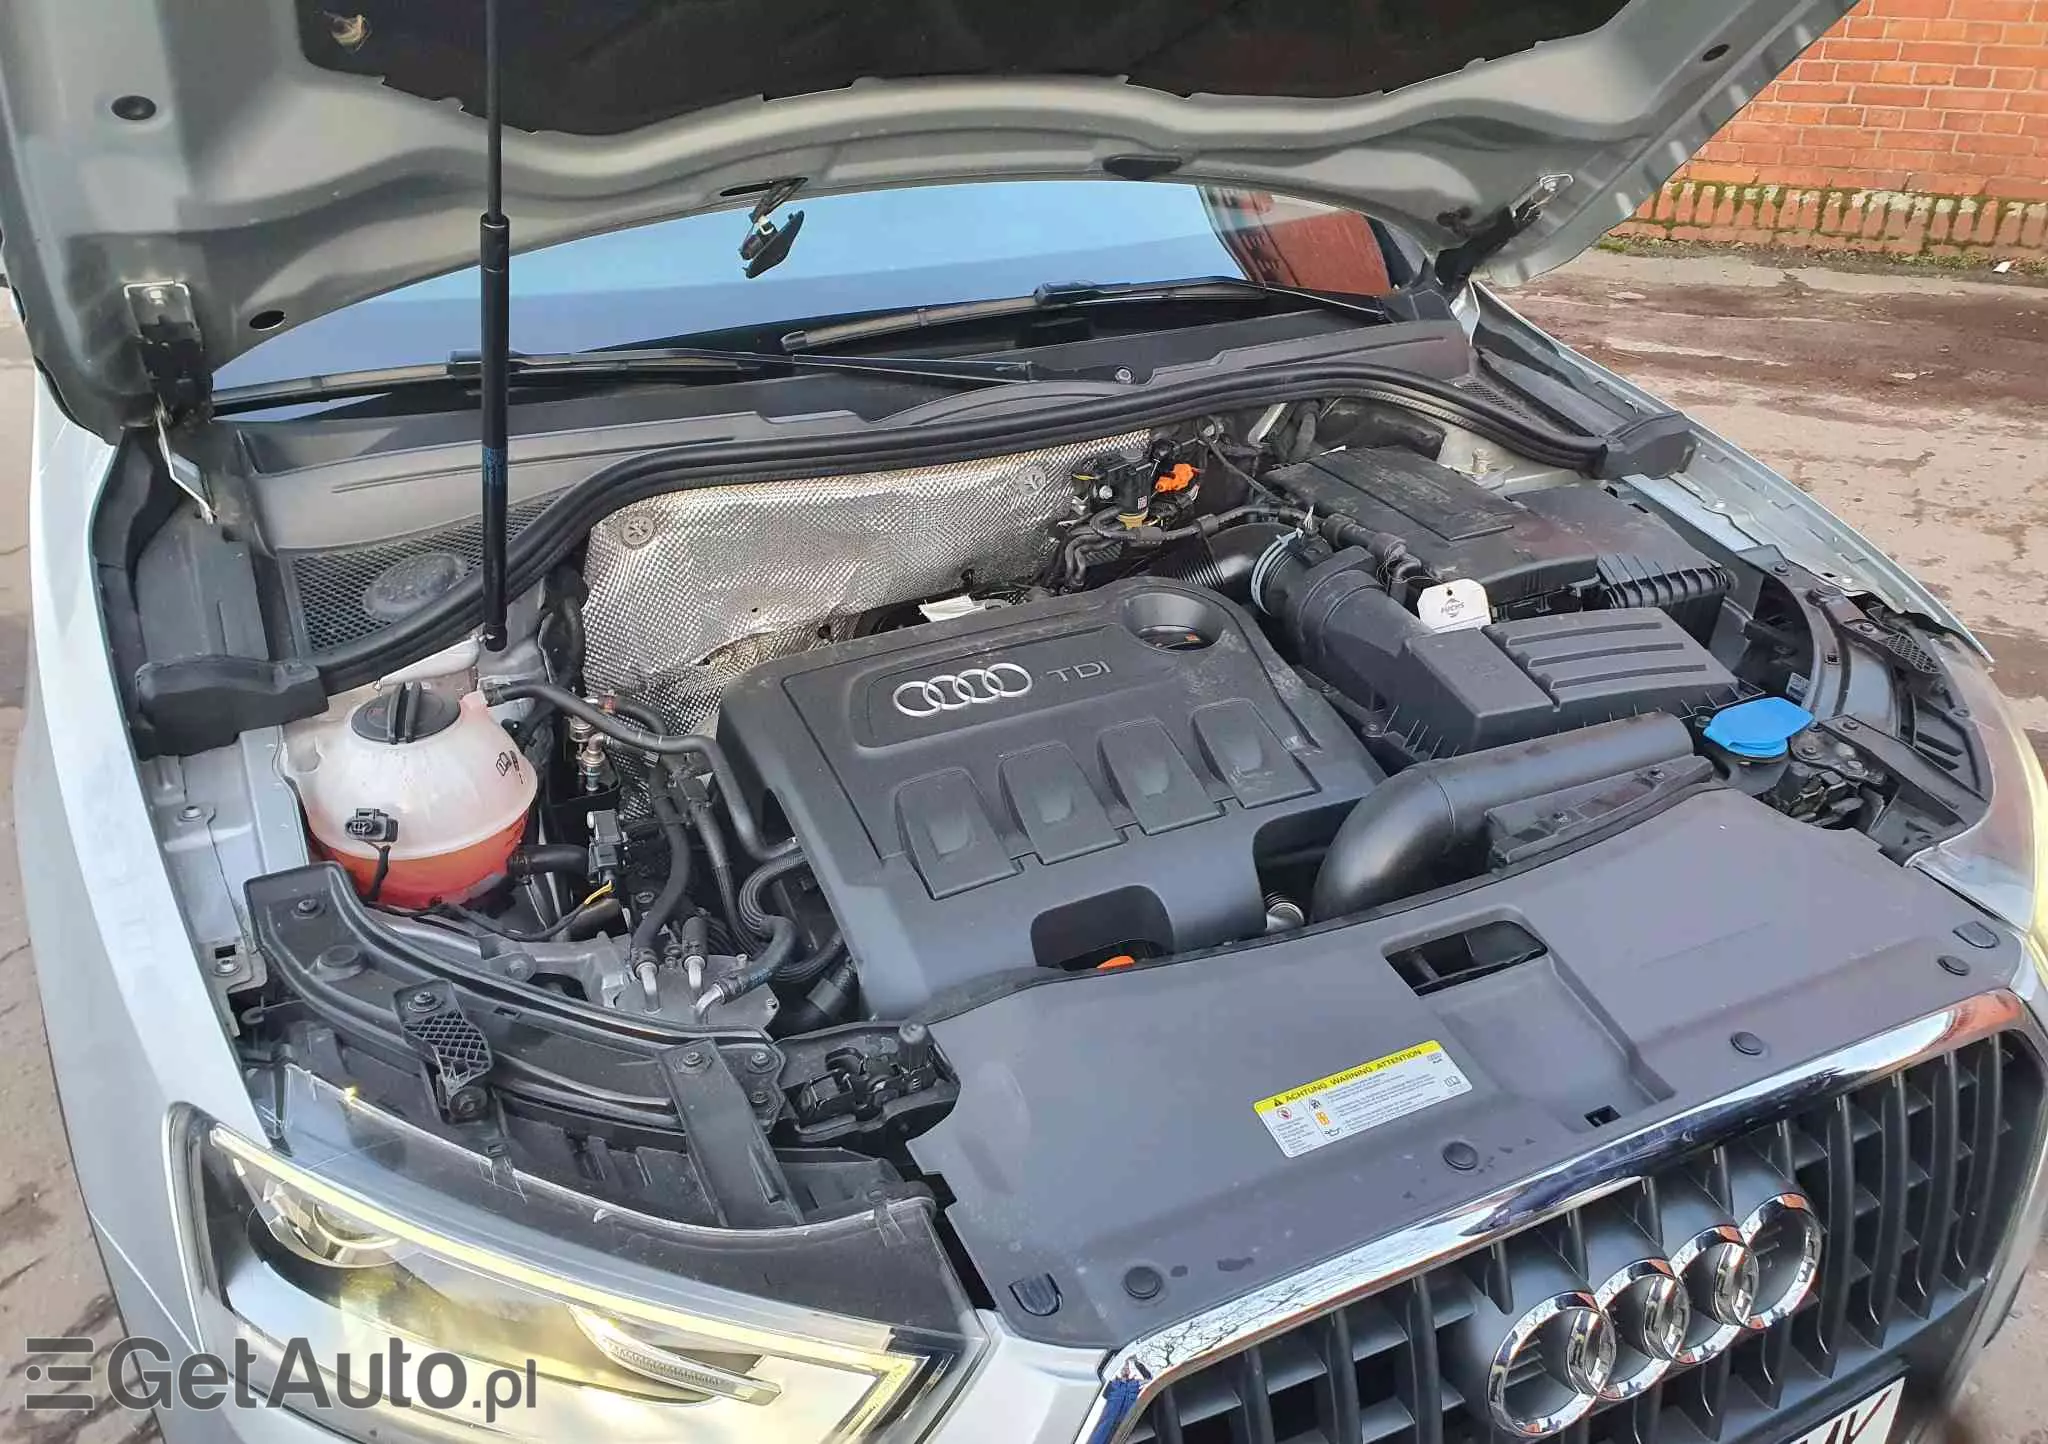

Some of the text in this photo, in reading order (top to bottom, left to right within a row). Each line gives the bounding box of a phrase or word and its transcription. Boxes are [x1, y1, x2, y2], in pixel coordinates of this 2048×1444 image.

[1048, 661, 1112, 682] TDI
[1285, 1082, 1327, 1101] ACHTUNG
[1330, 1065, 1373, 1085] WARNING
[1376, 1050, 1422, 1069] ATTENTION
